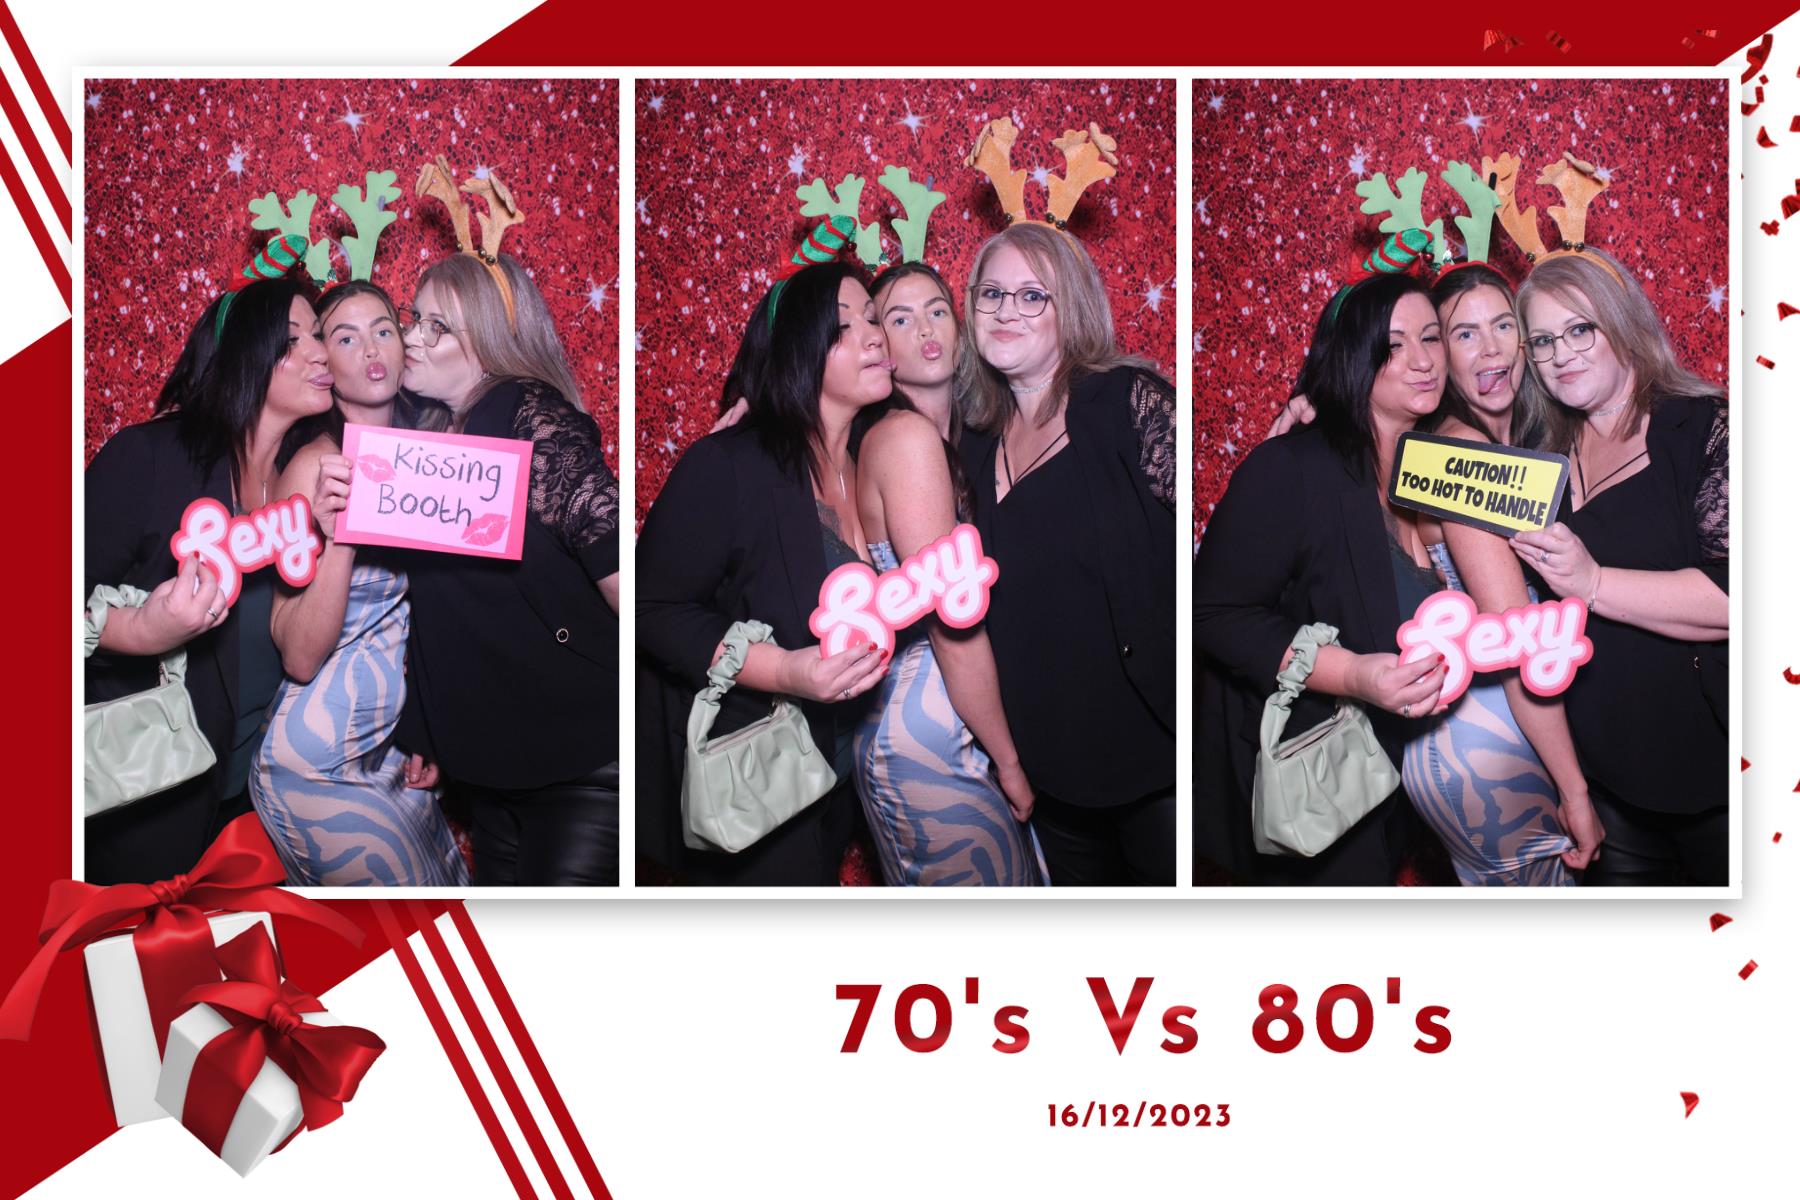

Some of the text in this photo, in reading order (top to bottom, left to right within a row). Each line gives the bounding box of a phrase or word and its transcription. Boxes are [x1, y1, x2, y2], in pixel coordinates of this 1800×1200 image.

[393, 443, 502, 502] Kissing
[1401, 471, 1547, 526] TOO HOT TO HANDLE
[1445, 456, 1527, 491] CAUTION!!
[377, 484, 472, 527] Booth
[173, 497, 321, 602] Sexy
[815, 527, 993, 660] Sexy
[1402, 597, 1586, 699] Sexy
